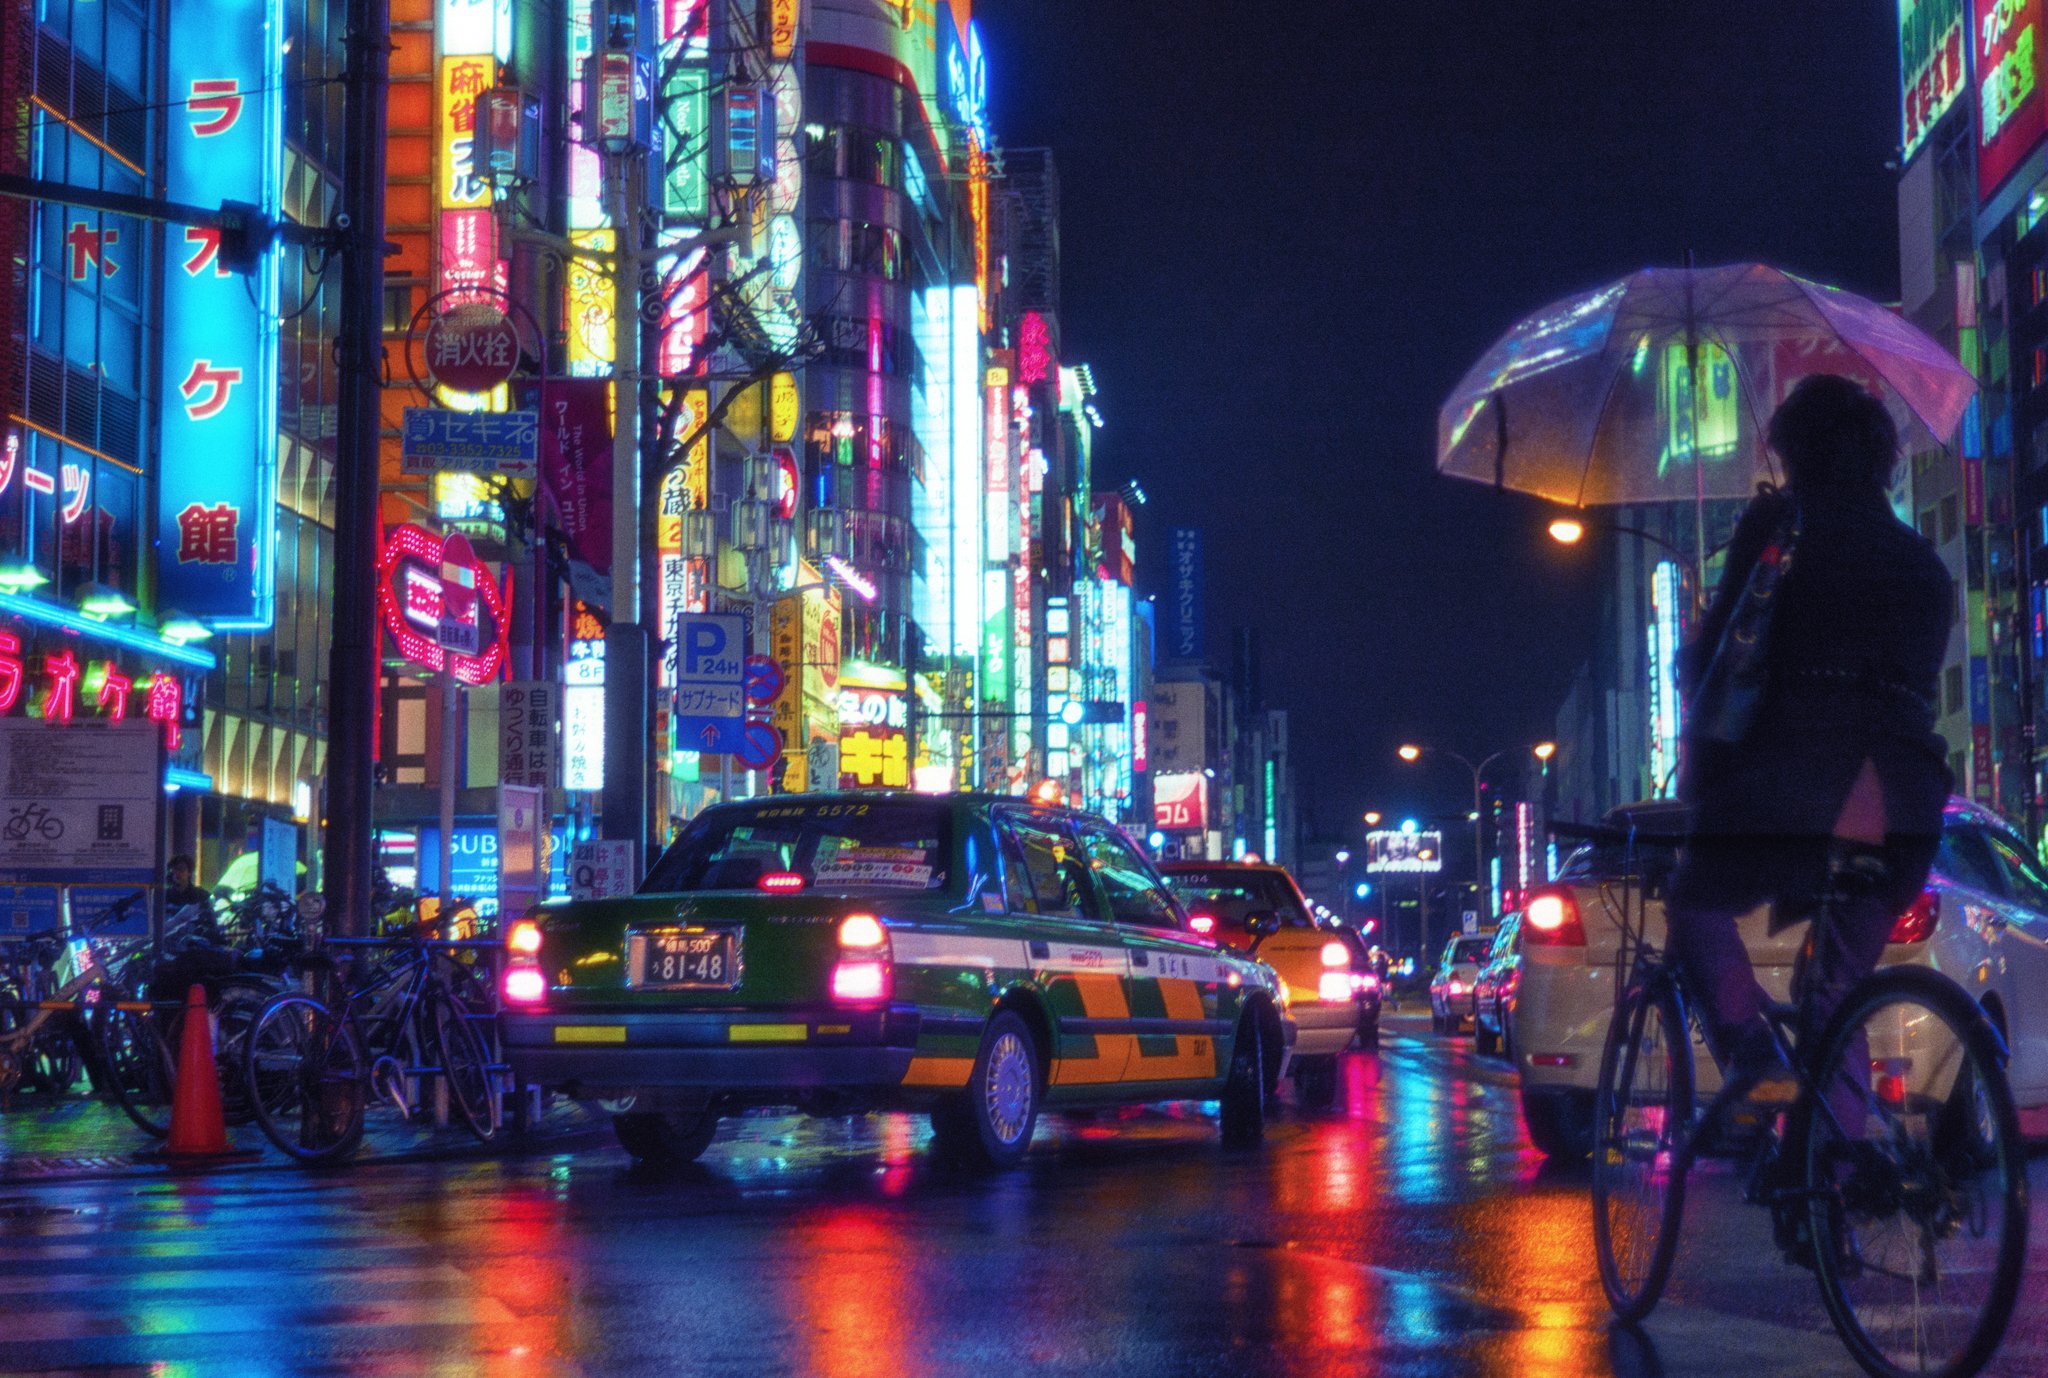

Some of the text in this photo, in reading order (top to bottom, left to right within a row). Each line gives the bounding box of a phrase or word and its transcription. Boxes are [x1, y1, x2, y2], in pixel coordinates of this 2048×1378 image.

[434, 332, 511, 367] 消火栓
[685, 621, 727, 674] P
[579, 663, 604, 679] 8F
[703, 660, 739, 675] 24H
[681, 691, 741, 711] サブナード
[816, 803, 871, 817] 5572
[689, 939, 711, 953] 500
[662, 955, 723, 980] 81-48
